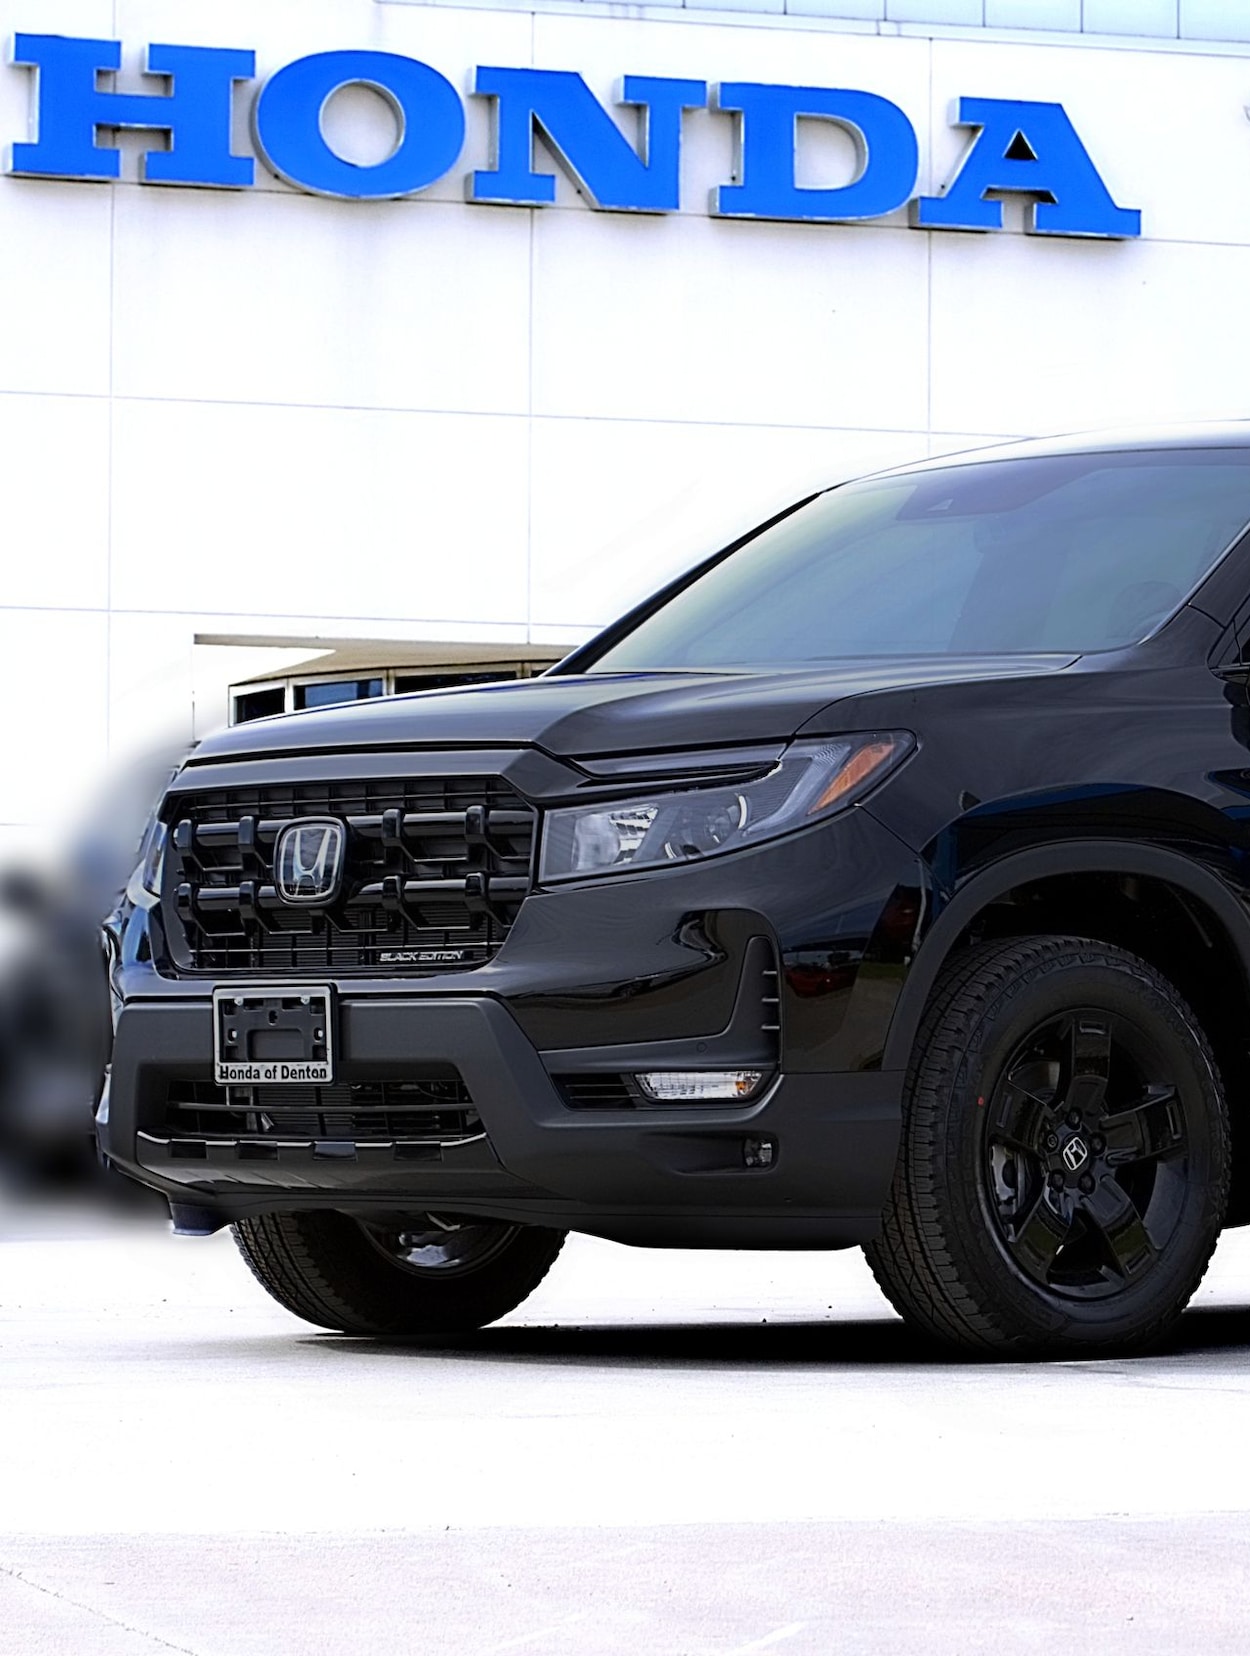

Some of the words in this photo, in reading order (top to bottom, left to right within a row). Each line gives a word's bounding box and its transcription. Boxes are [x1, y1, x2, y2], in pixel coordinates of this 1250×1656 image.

[6, 33, 1142, 239] HONDA
[380, 952, 418, 961] BLACK
[418, 950, 464, 960] EDITION
[219, 1065, 261, 1080] Honda
[264, 1065, 278, 1079] of
[281, 1064, 327, 1079] Denton
